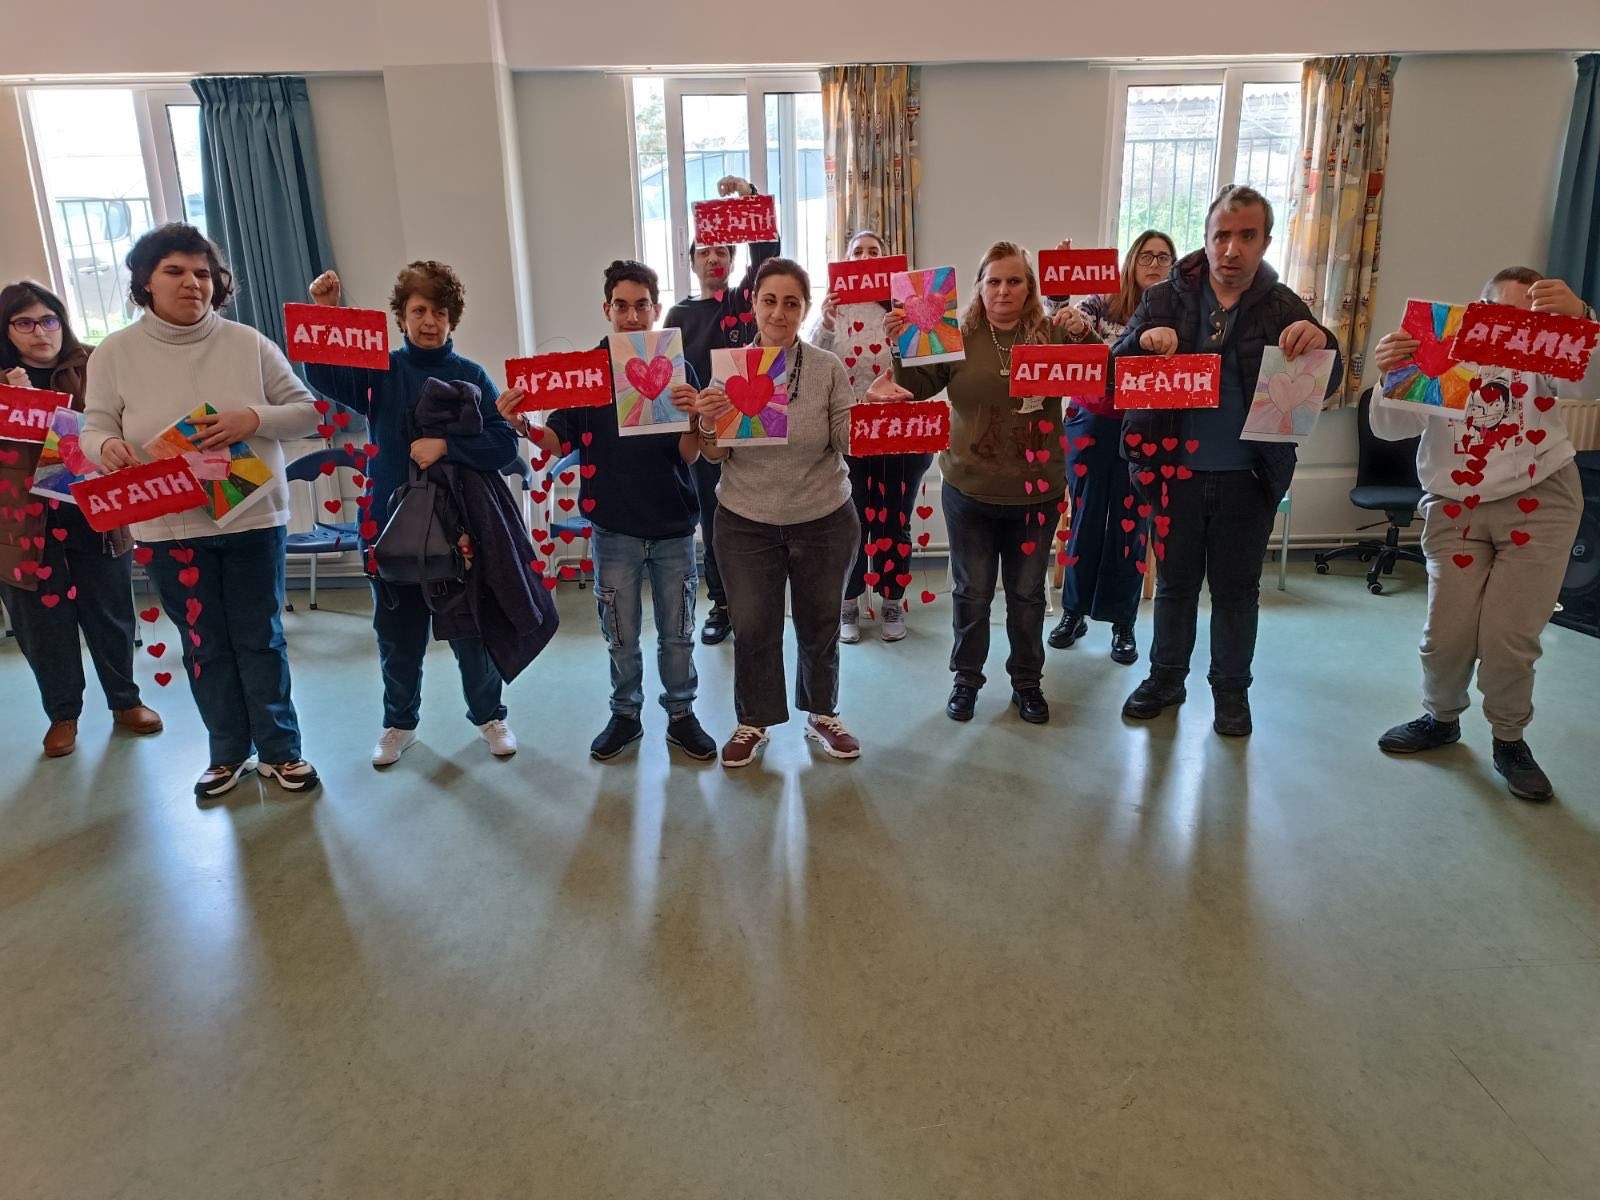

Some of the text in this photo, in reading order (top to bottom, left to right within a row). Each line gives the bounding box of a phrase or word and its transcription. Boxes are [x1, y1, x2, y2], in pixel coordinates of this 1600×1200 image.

[834, 272, 892, 292] ΑΓΑΠ
[1044, 264, 1116, 282] ΑΓΑΠΗ
[293, 323, 384, 351] ΑΓΑΠΗ
[1463, 321, 1587, 364] ΑΓΑΠΗ
[513, 367, 604, 395] ΑΓΑΠΗ
[1015, 363, 1102, 381] ΑΓΑΠΗ
[1120, 370, 1213, 392] ΑΓΑΠΗ
[853, 415, 943, 440] ΑΓΑΠΗ
[88, 470, 194, 515] ΑΓΑΠΗ
